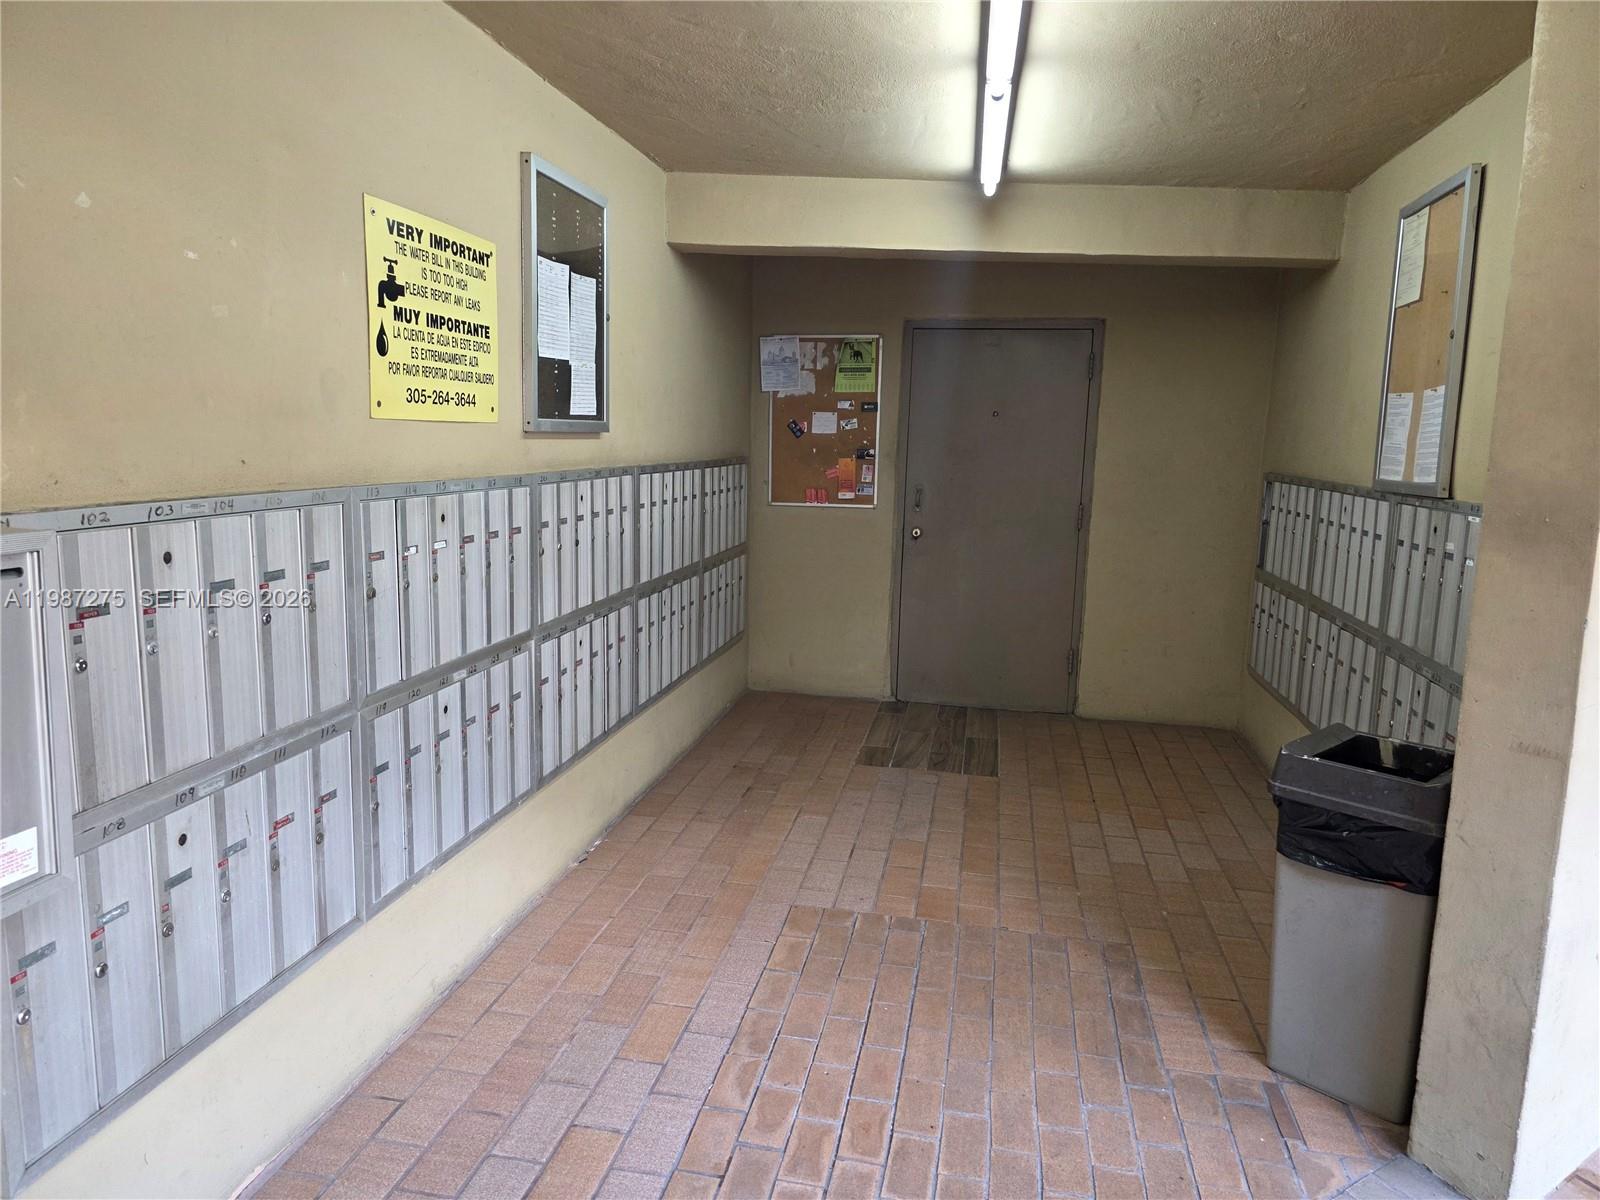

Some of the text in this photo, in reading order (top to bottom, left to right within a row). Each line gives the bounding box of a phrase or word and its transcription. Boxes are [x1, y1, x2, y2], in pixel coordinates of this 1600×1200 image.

[386, 218, 491, 267] VERY IMPORTANT
[394, 241, 487, 281] THE WATER BILL IN THIS BUILDING
[422, 267, 468, 291] IS TOO TOO HIGH
[405, 281, 481, 312] PLEASE REPORT ANY LEAKS
[393, 305, 490, 339] MUY IMPORTANTE
[393, 326, 491, 354] LA CUENTA DE AGUA EN ESTE EDIFICIO
[410, 346, 478, 367] ES EXTREMADAMENTE ALTA
[388, 361, 494, 385] POR FAVOR REPORTAR CUALQUIER SALIDERO
[406, 387, 476, 407] 305-264-3644
[147, 504, 174, 522] 103
[213, 498, 234, 513] 104
[80, 511, 110, 526] 102
[408, 689, 421, 700] 120
[375, 702, 387, 716] 119
[320, 724, 338, 739] 112
[273, 748, 287, 762] 111
[230, 765, 247, 782] 110
[176, 787, 195, 806] 109
[102, 817, 126, 839] 108
